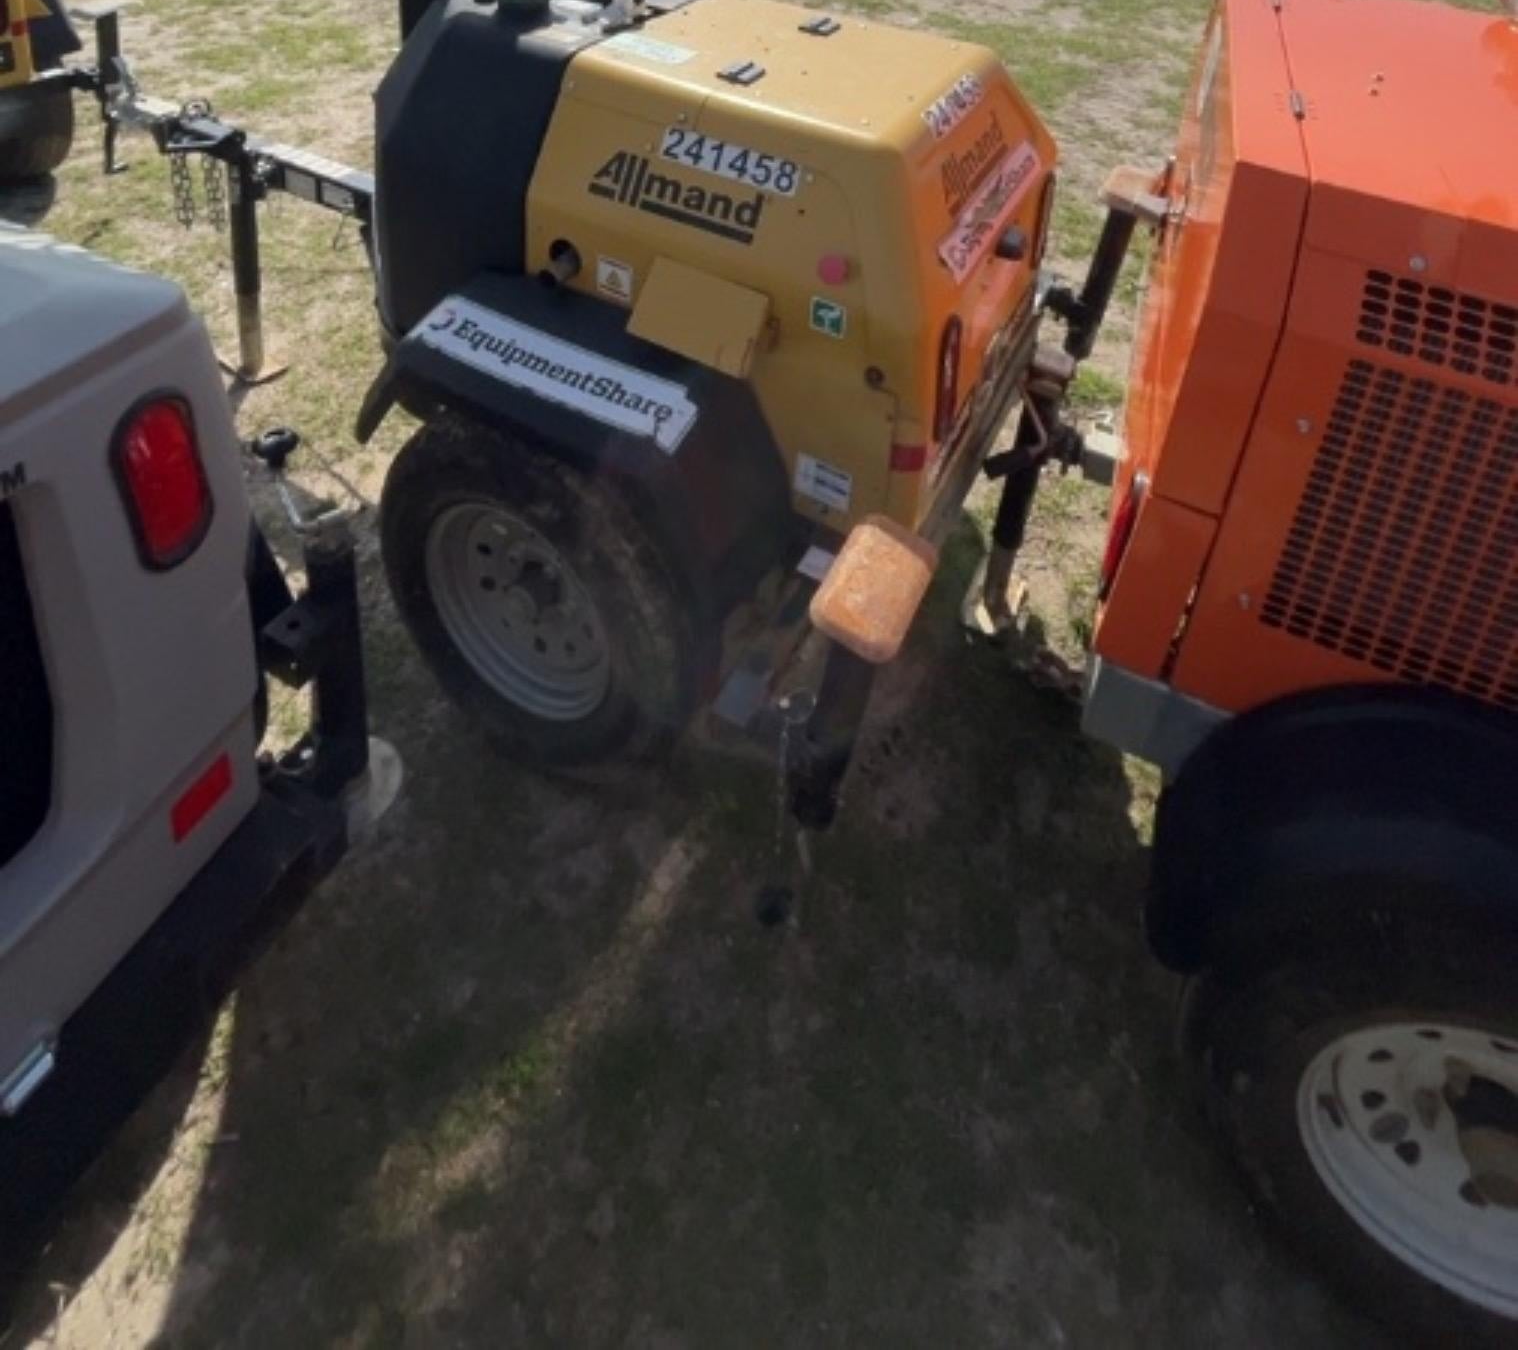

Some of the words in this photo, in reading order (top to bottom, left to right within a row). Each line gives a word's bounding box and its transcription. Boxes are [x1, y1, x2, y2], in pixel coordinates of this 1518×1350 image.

[593, 151, 765, 229] Allmand
[663, 128, 797, 193] 241458
[452, 317, 673, 423] EquipmentShare
